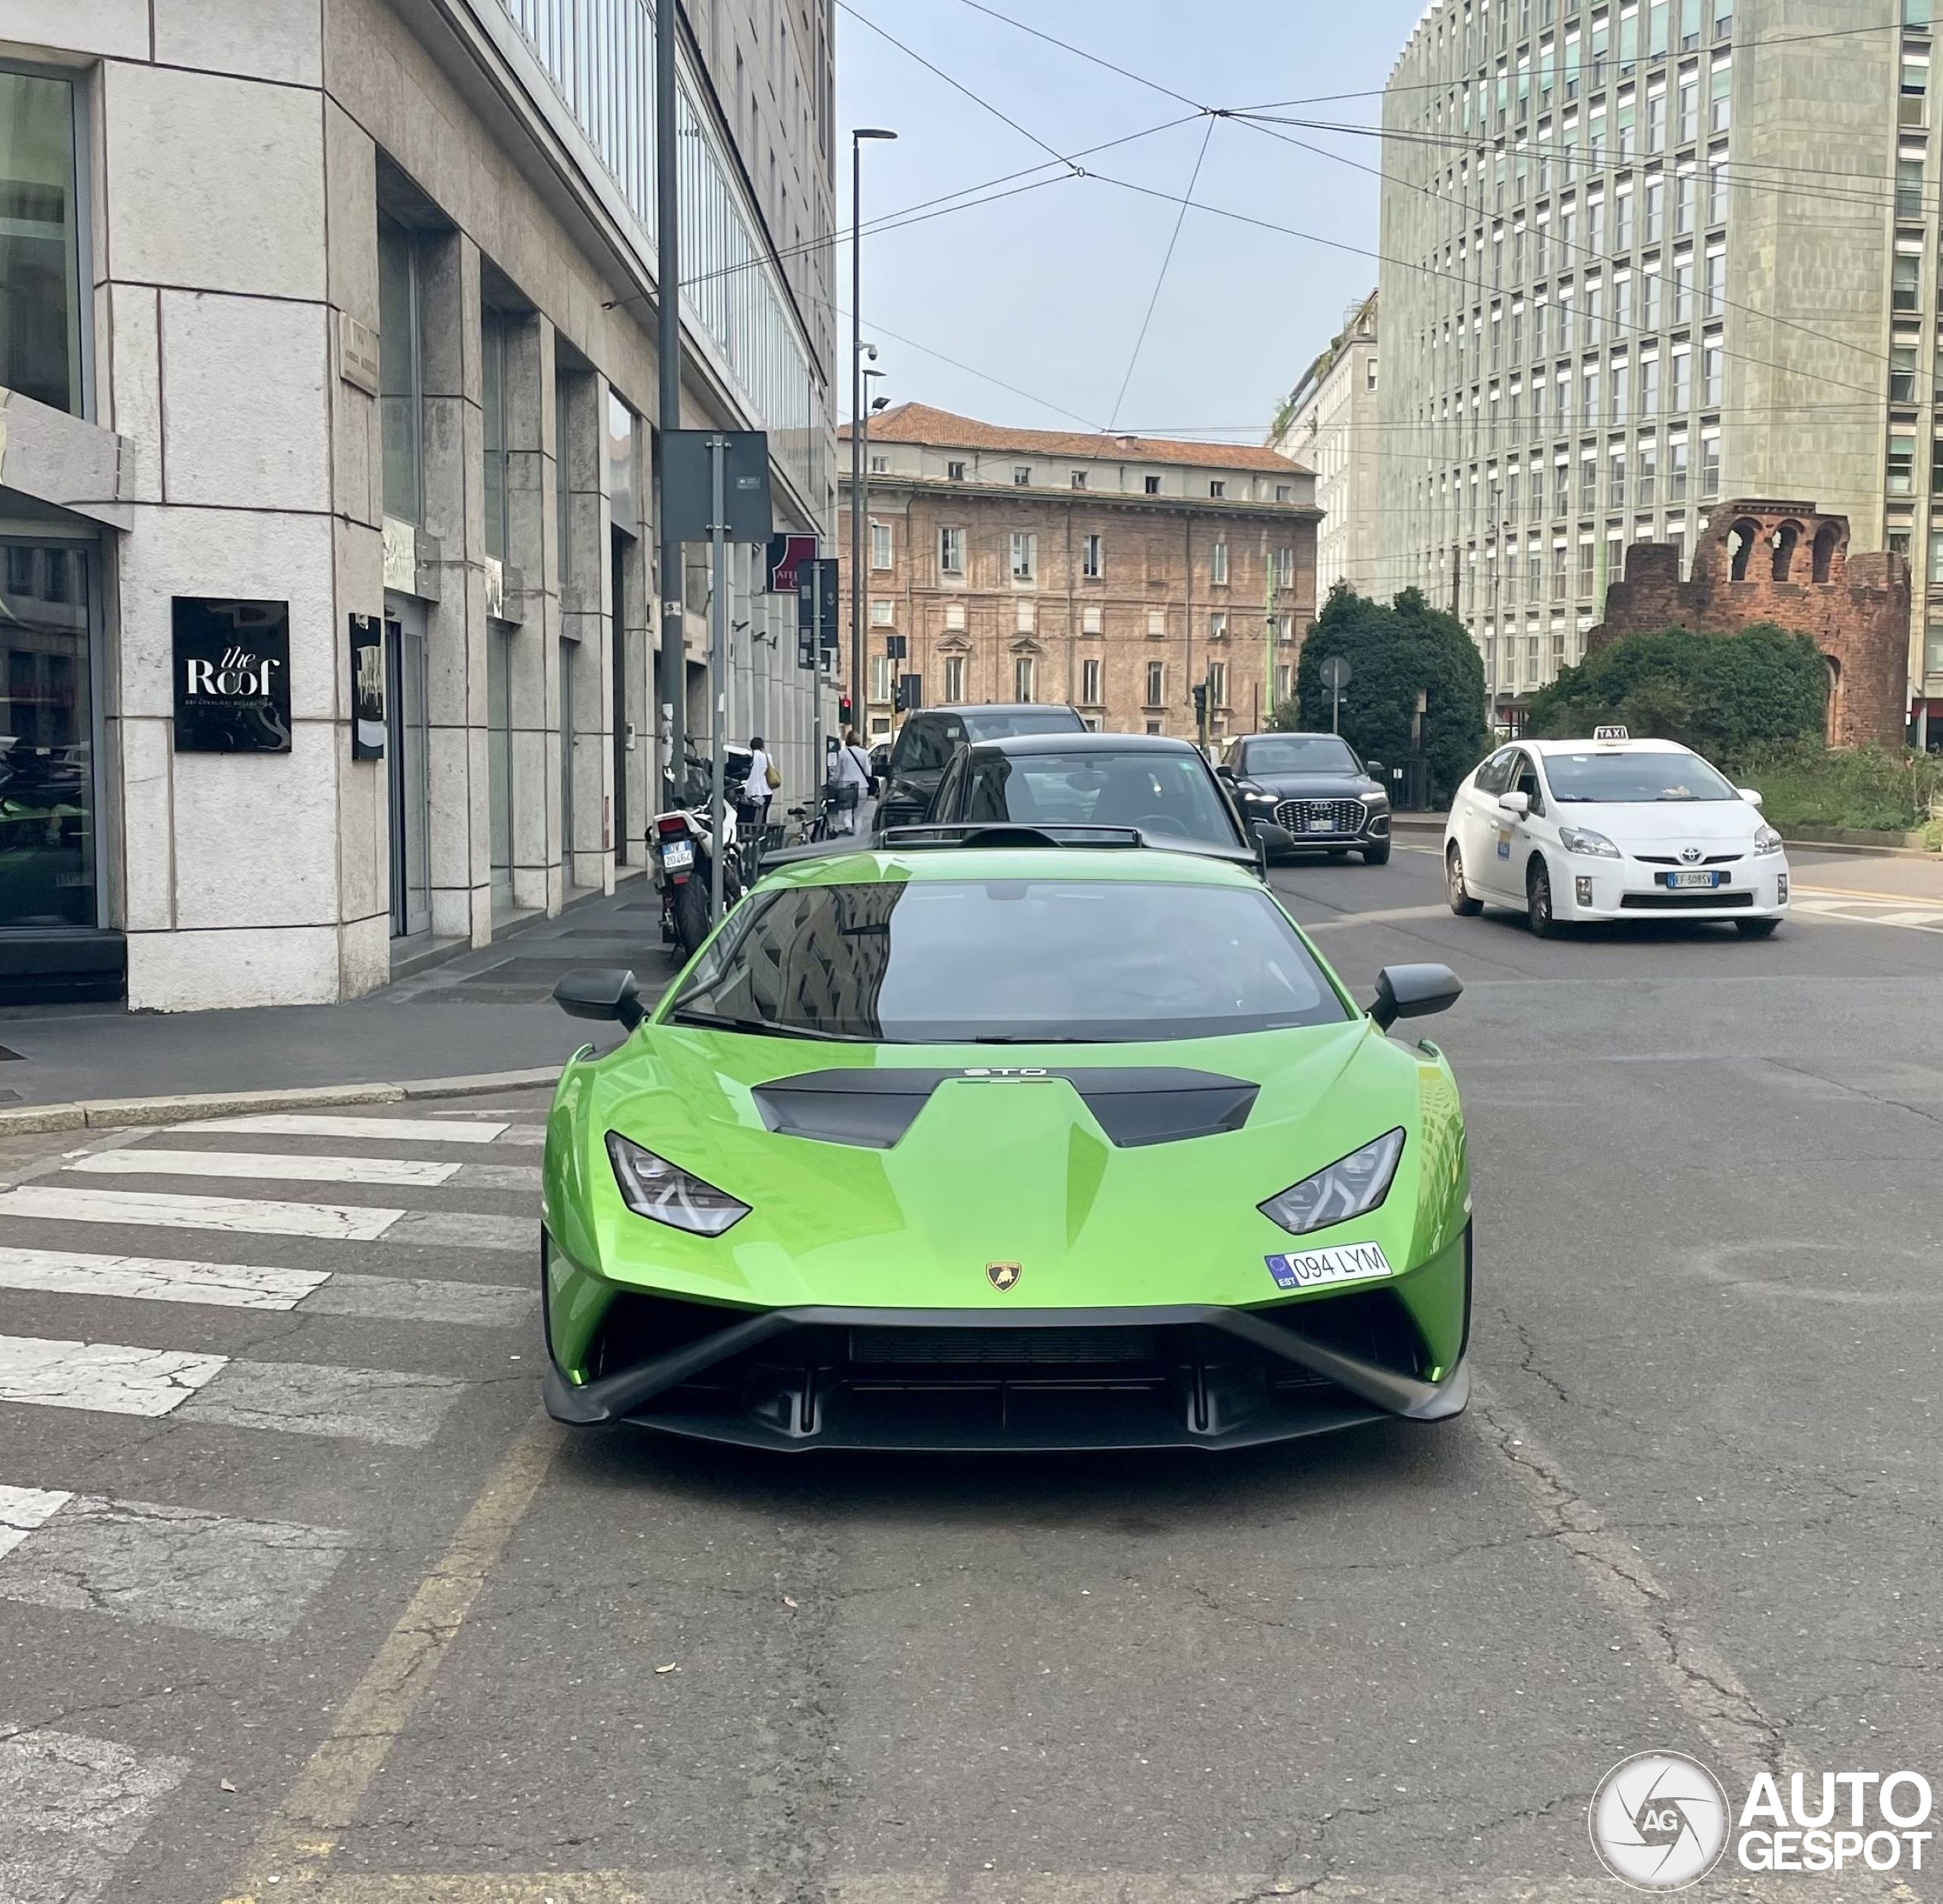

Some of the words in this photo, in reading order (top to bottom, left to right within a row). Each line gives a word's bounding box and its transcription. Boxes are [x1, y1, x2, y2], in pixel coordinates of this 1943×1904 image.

[221, 646, 257, 669] the
[184, 658, 281, 695] Roof
[1598, 728, 1624, 739] TAXI
[1293, 1254, 1334, 1279] 094
[1335, 1247, 1386, 1273] LYM
[1277, 1277, 1296, 1287] EST
